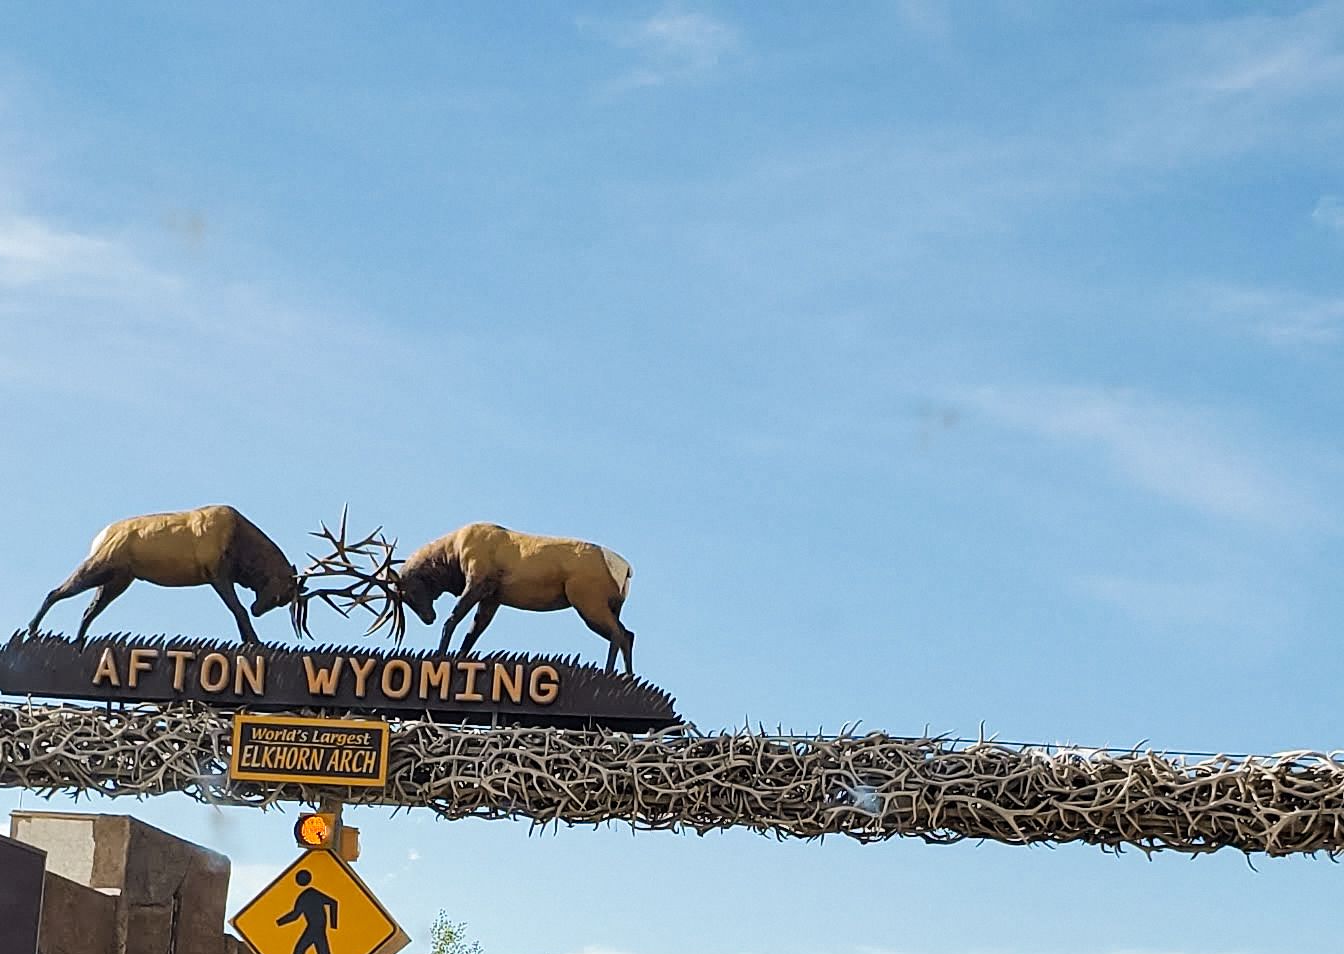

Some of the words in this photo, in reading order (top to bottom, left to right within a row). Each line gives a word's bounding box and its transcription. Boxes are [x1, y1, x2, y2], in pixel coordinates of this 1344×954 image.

[93, 647, 264, 696] AFTON
[303, 655, 560, 705] WYOMING
[251, 727, 307, 742] World's
[312, 730, 371, 746] Largest
[240, 745, 324, 771] ELKHORN
[326, 749, 377, 774] ARCH
